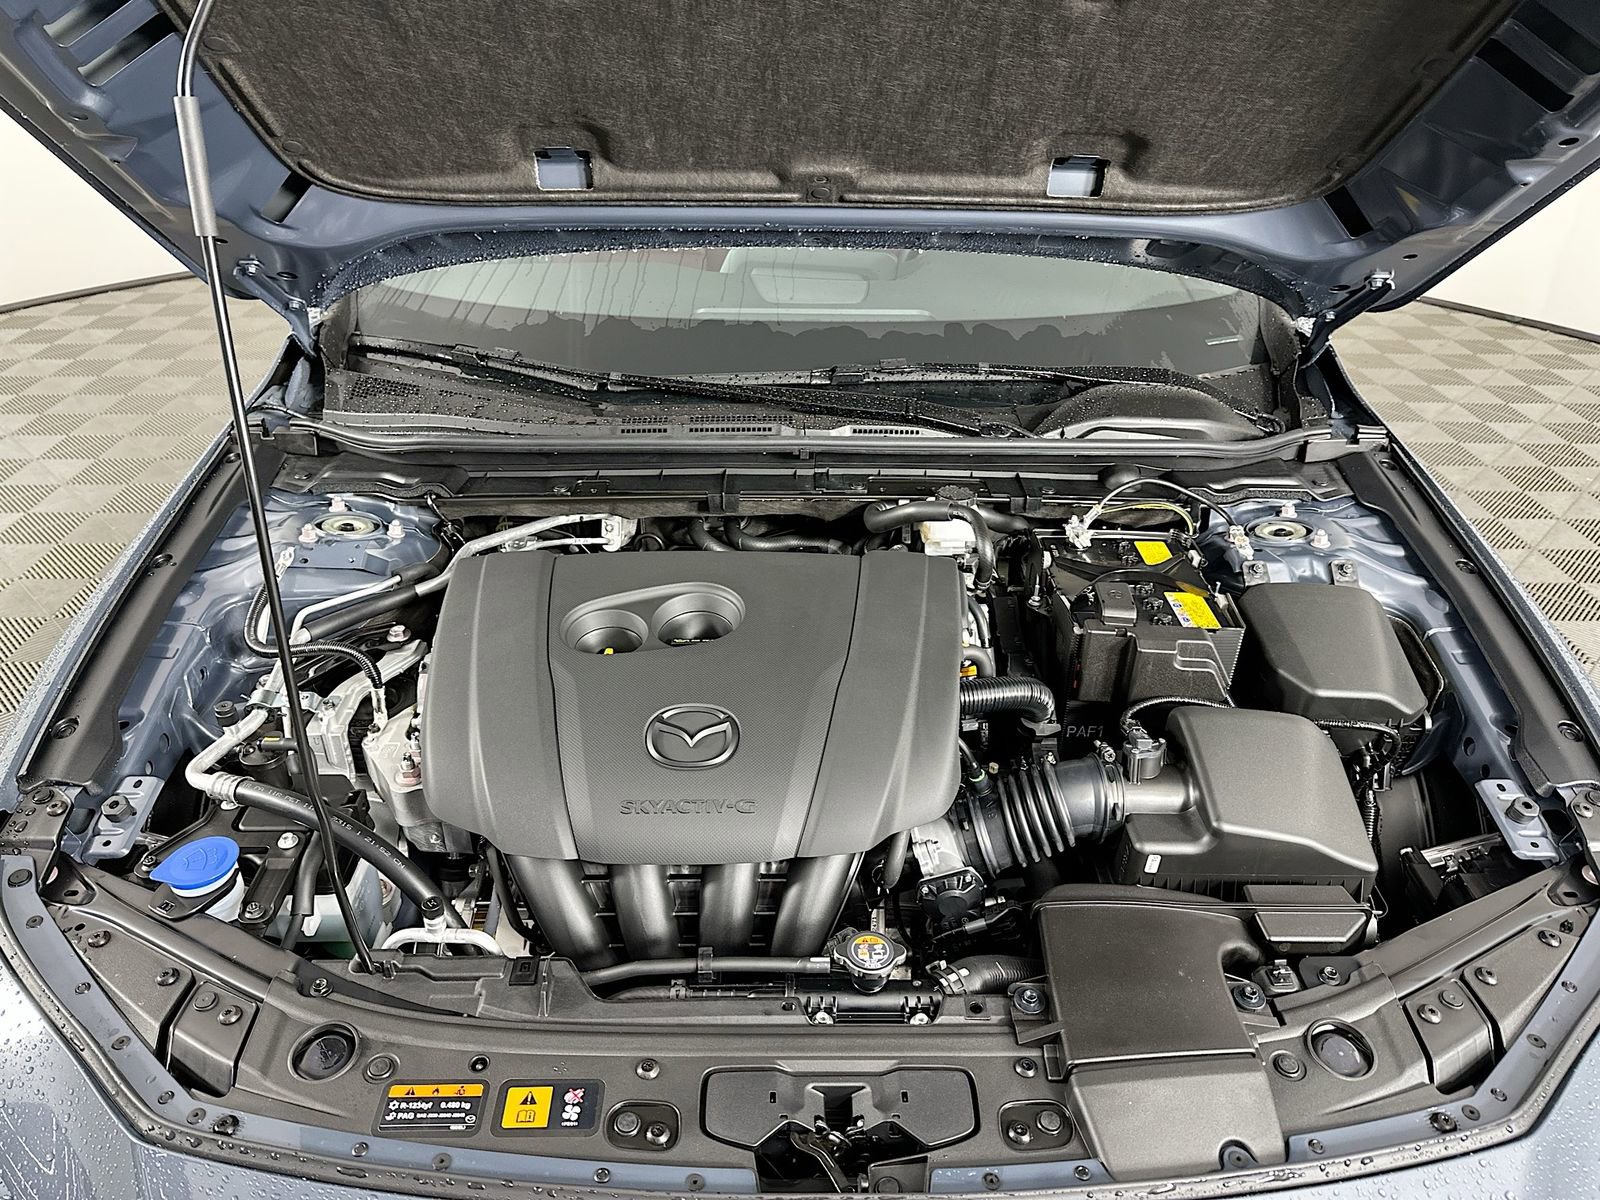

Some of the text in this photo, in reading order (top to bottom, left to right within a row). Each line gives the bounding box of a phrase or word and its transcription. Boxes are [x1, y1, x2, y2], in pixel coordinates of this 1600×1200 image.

[1066, 725, 1104, 738] PAF1
[619, 798, 757, 815] SKYACTIV-G
[400, 1101, 433, 1111] R-1234yf
[461, 1101, 472, 1110] kg
[397, 1112, 415, 1120] PAG
